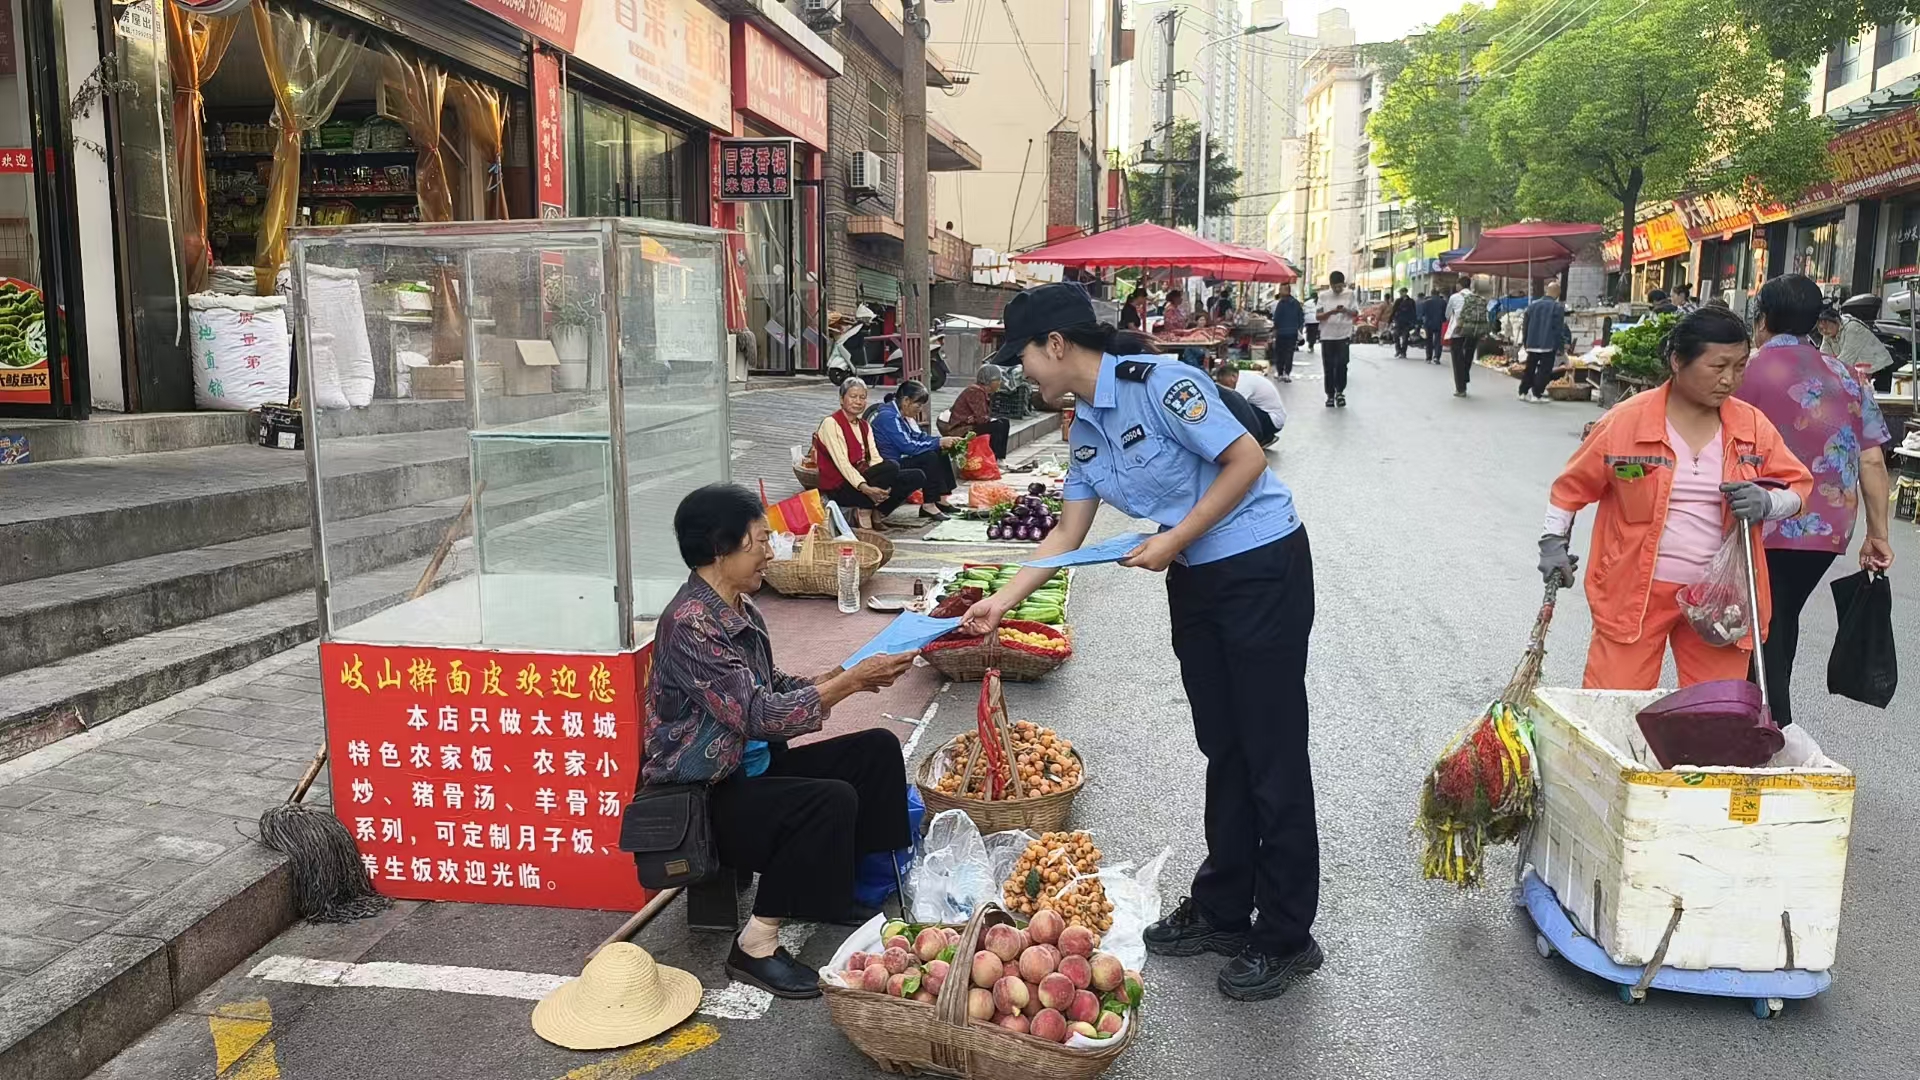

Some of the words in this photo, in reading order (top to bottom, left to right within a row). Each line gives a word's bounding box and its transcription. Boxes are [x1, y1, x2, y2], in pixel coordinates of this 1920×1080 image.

[1, 153, 34, 168] 欢迎
[725, 146, 787, 175] 冒菜香锅
[725, 177, 788, 193] 米饭免费
[340, 653, 616, 703] 岐山擀面皮欢迎您
[407, 704, 617, 740] 本店只做太极城
[348, 740, 619, 778] 特色农家饭、农家小
[352, 778, 621, 817] 炒、猪骨汤、羊骨汤
